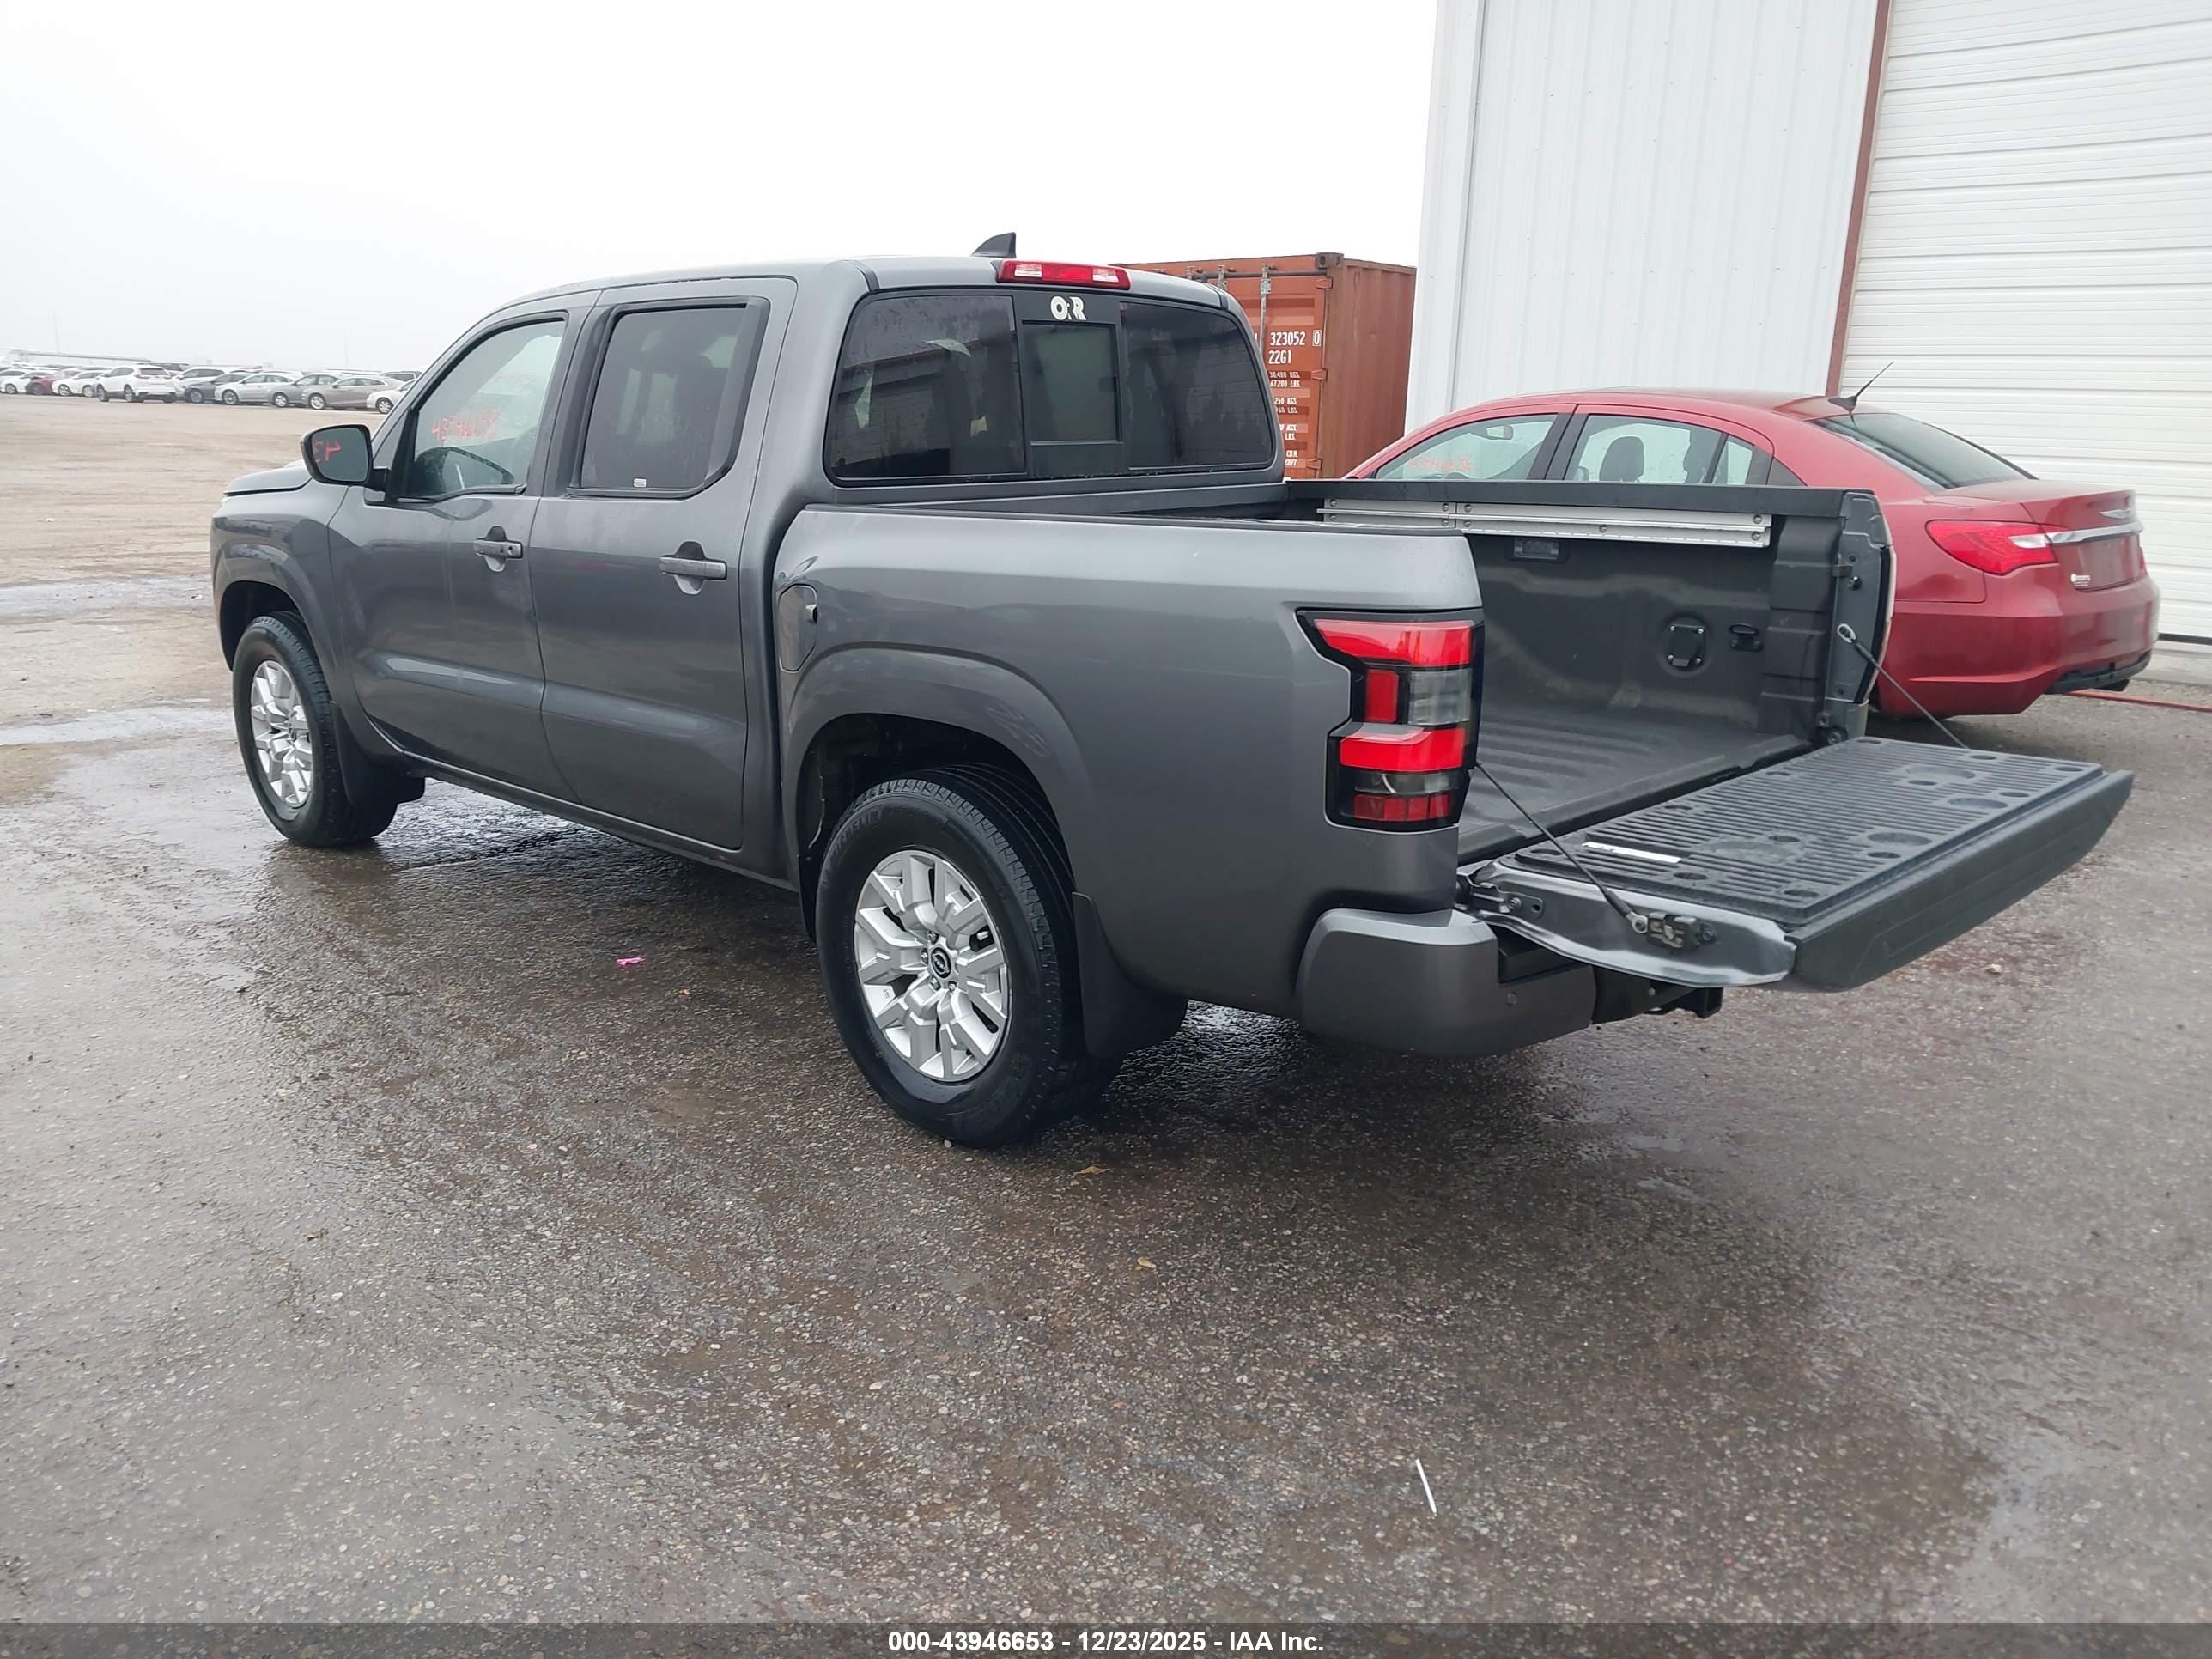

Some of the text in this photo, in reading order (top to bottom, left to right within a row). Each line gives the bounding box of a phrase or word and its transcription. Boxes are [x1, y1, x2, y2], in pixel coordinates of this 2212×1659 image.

[1270, 331, 1306, 346] 323052
[1313, 330, 1322, 346] 0
[1268, 349, 1292, 364] 22G1
